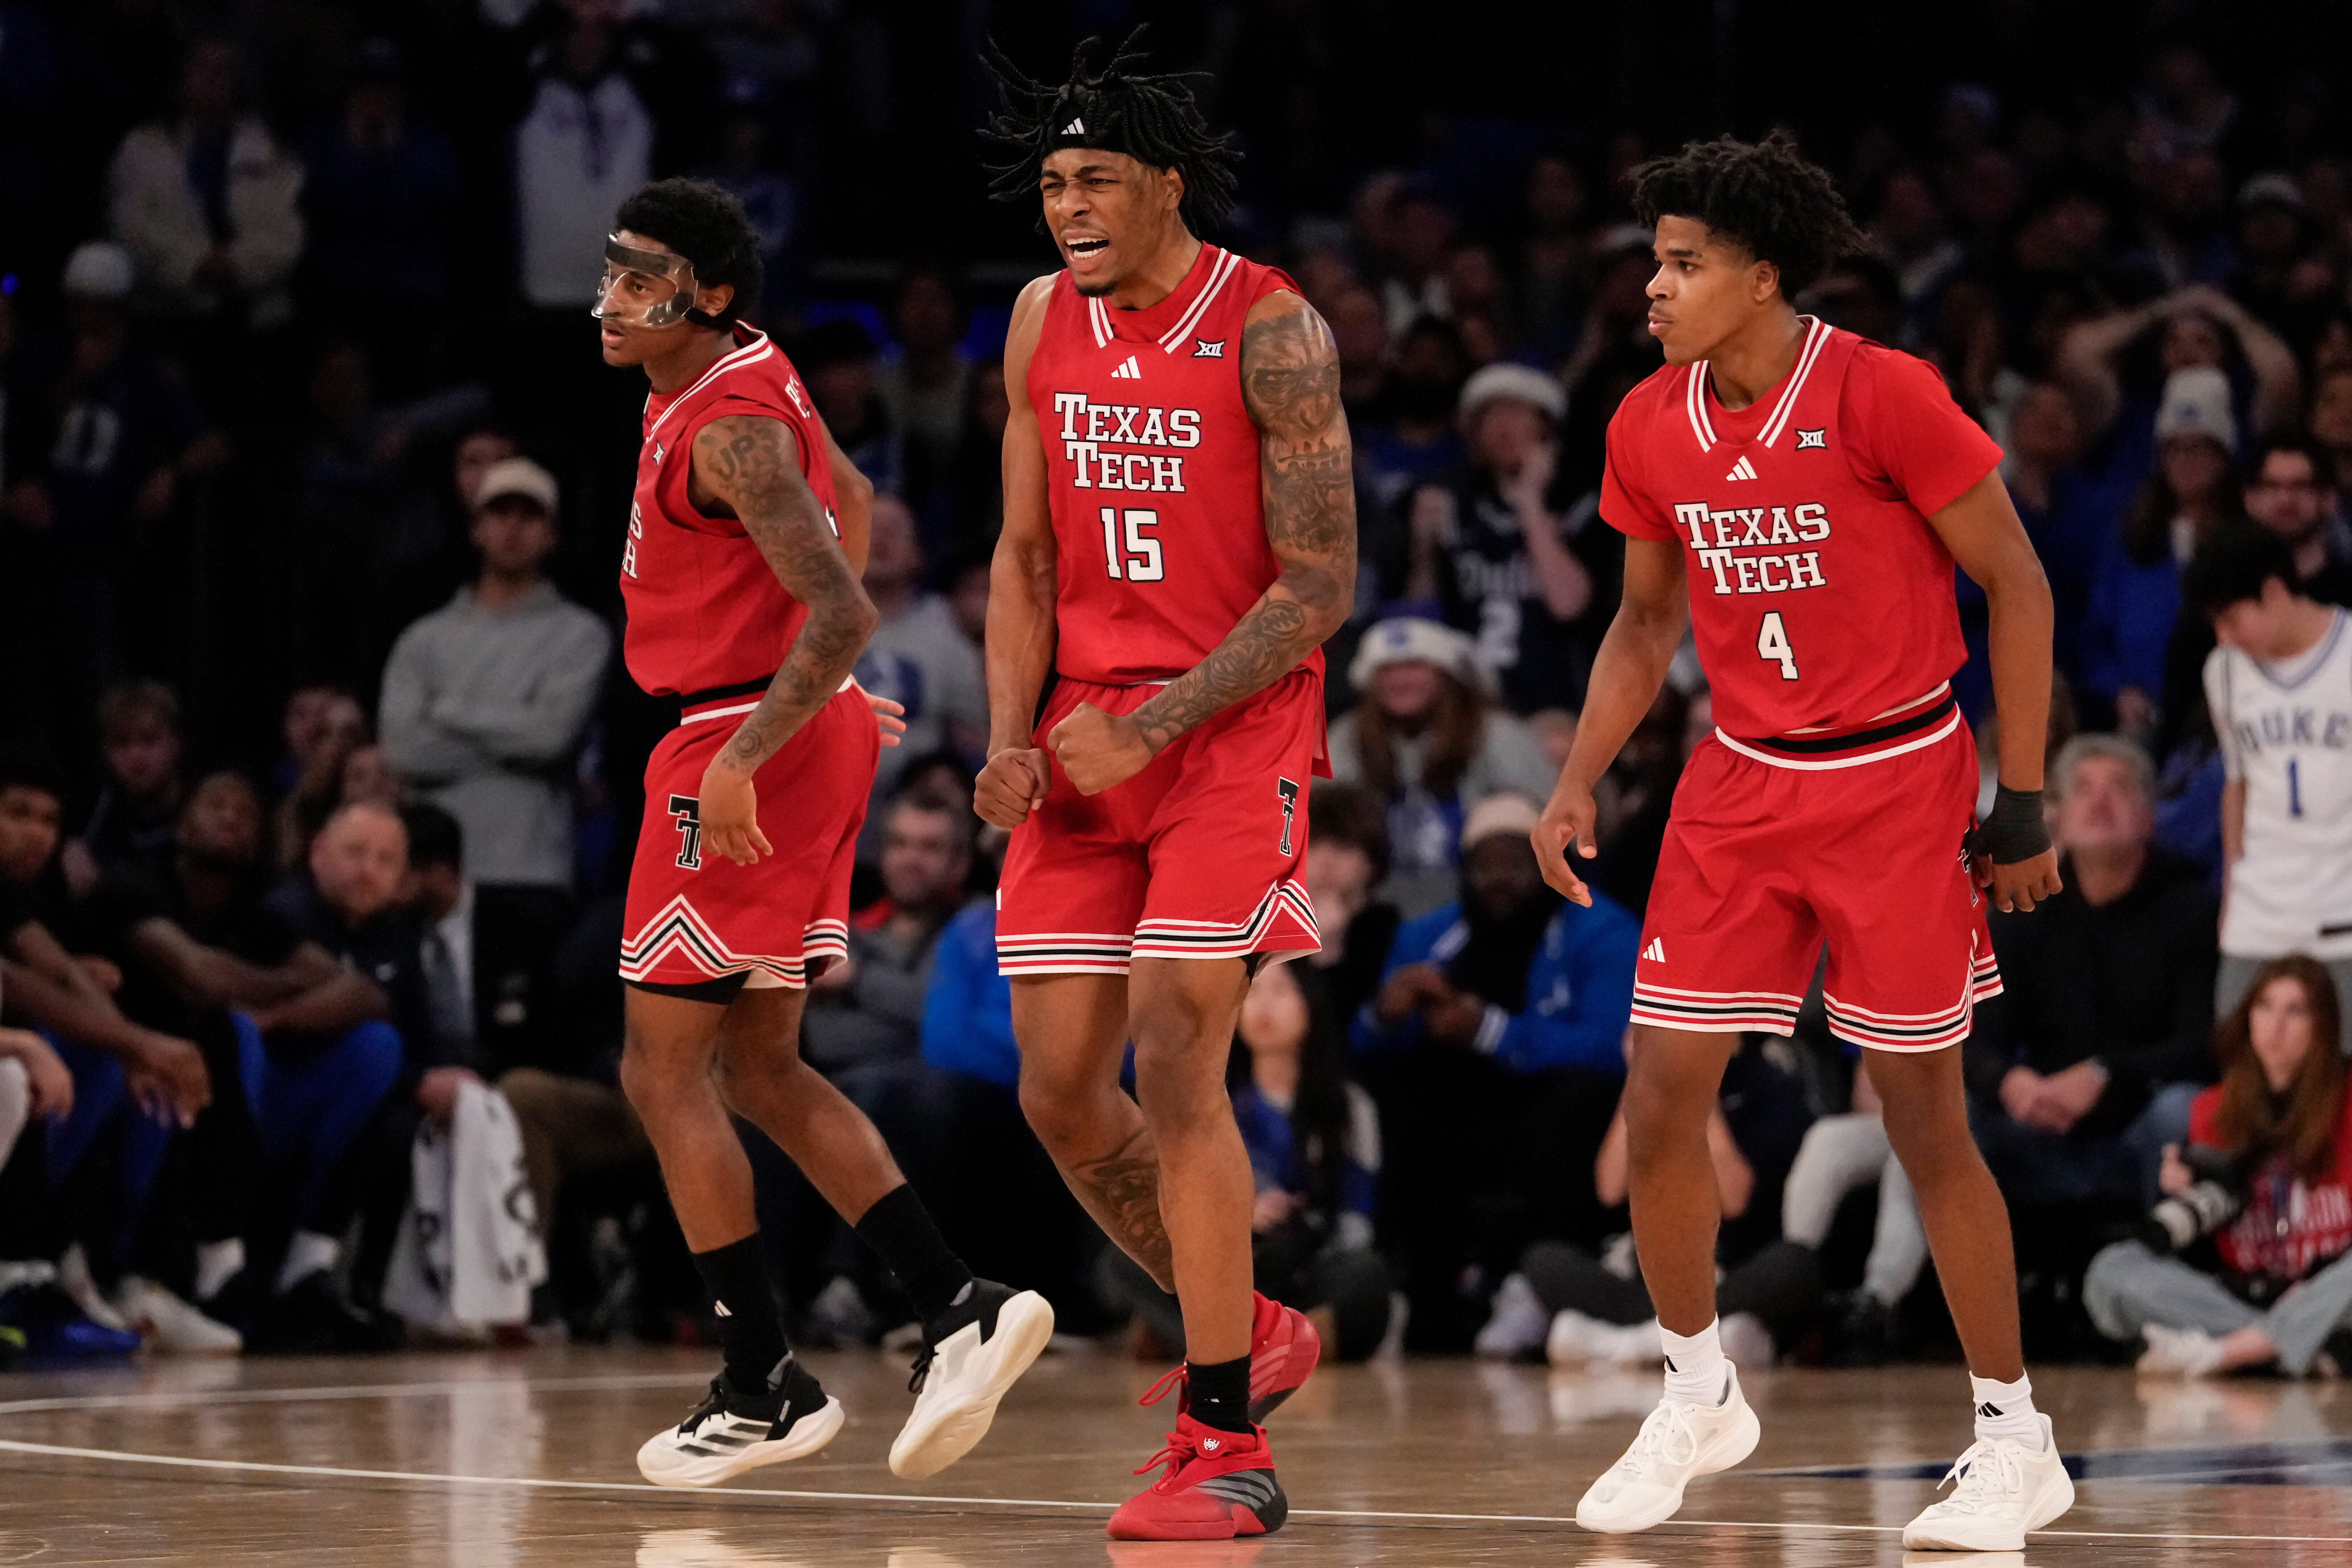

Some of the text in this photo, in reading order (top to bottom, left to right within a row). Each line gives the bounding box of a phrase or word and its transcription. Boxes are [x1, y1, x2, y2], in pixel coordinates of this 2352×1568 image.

[1054, 391, 1202, 448] TEXAS
[1066, 440, 1186, 493] TECH
[1099, 506, 1165, 582] 15
[1673, 502, 1831, 549] TEXAS
[1697, 548, 1826, 595] TECH
[1756, 610, 1799, 681] 4
